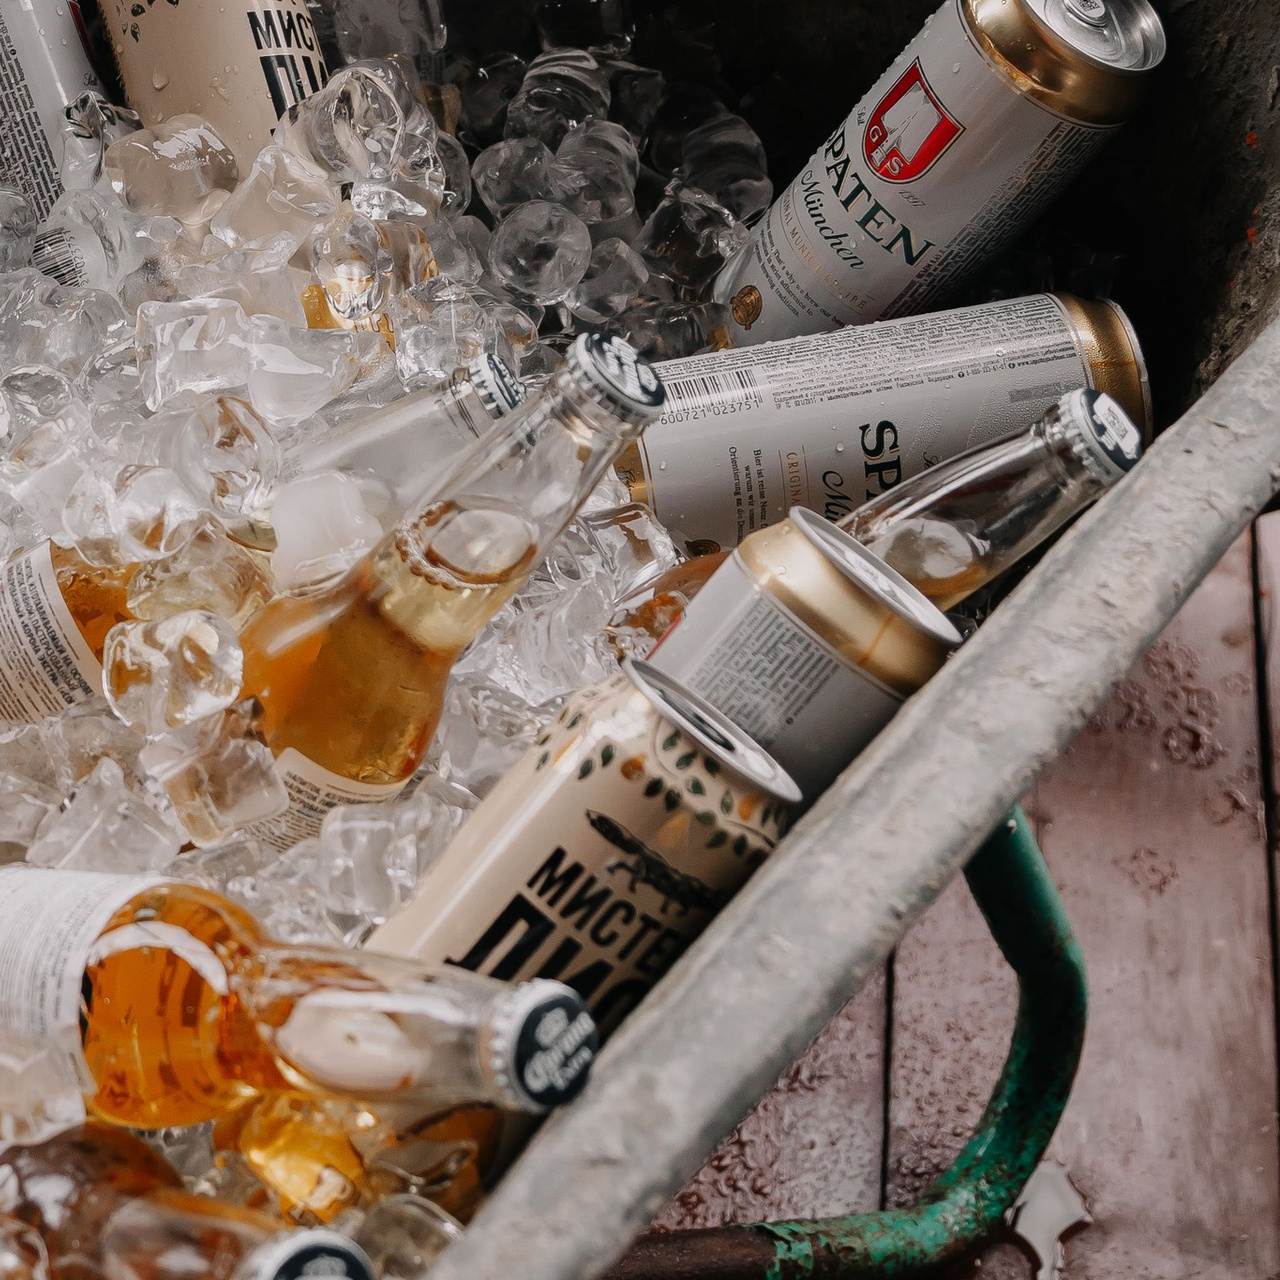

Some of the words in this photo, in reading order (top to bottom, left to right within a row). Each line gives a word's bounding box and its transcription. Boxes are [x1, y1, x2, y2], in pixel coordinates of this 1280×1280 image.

[260, 54, 328, 136] ЛИ
[870, 125, 883, 143] G
[885, 155, 903, 175] S
[801, 170, 864, 270] München
[824, 122, 939, 267] PATEN
[804, 292, 821, 308] brew
[660, 405, 708, 427] 600721
[712, 398, 760, 419] 023751
[753, 449, 762, 467] Bier
[786, 452, 801, 506] ORIGINA
[30, 618, 79, 692] ПАСТЕРИЗОВАННЫЙ
[60, 653, 74, 668] НА
[527, 846, 680, 974] МИСТЕ
